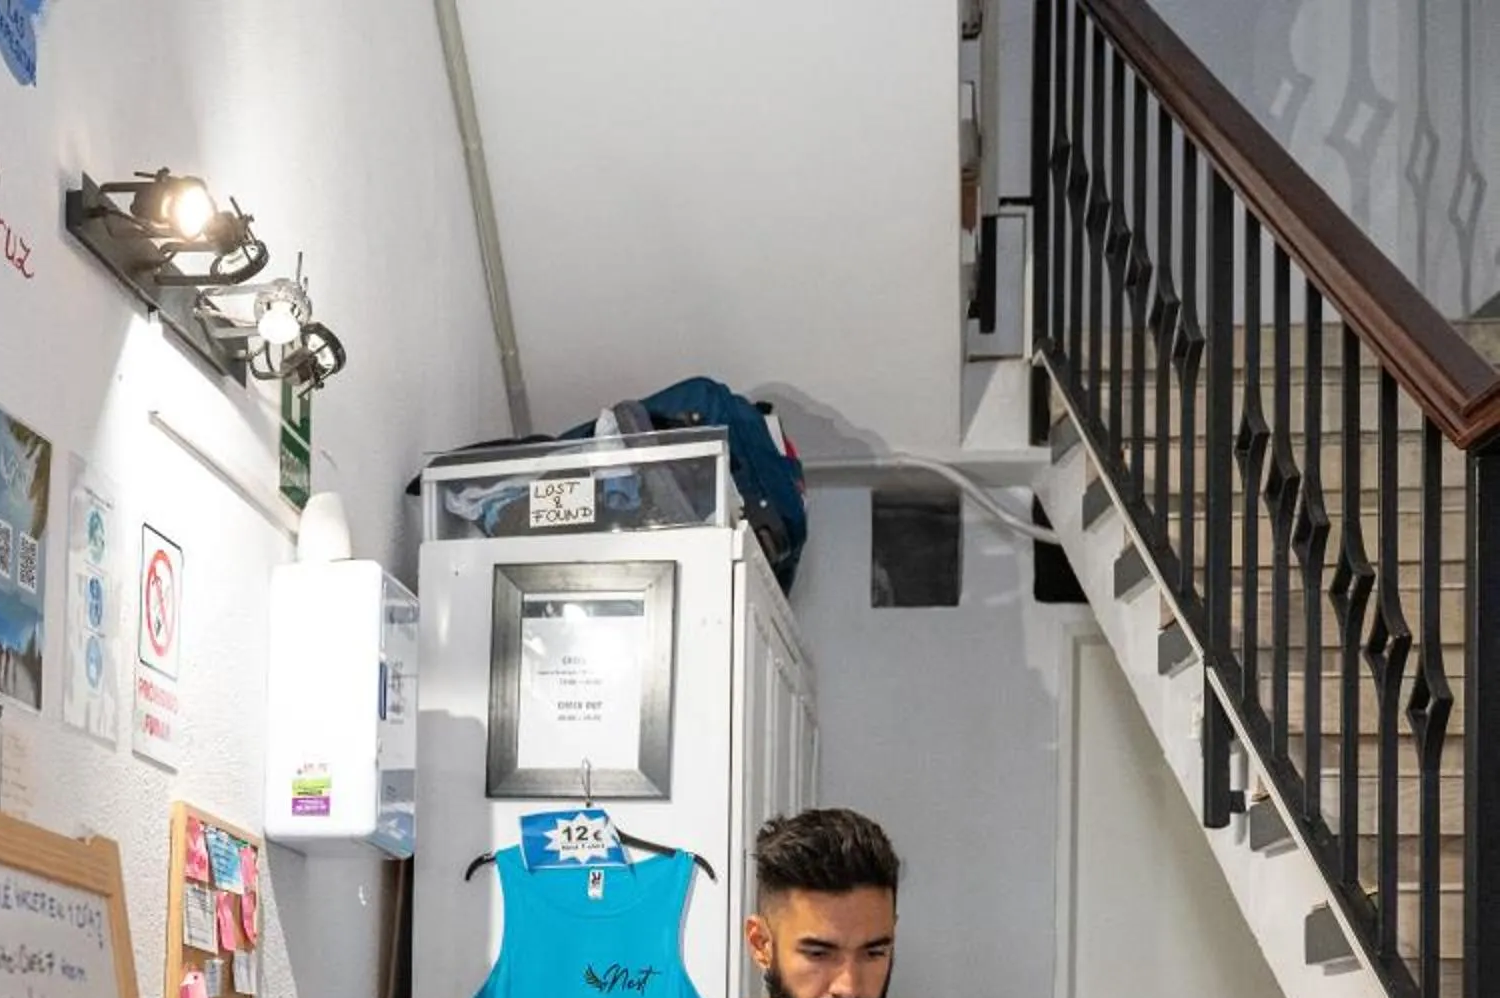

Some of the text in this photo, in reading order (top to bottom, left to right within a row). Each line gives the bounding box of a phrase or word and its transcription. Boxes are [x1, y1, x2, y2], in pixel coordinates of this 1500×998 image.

[534, 482, 581, 499] LOST
[532, 506, 593, 524] FOUND
[600, 963, 661, 996] Nest
